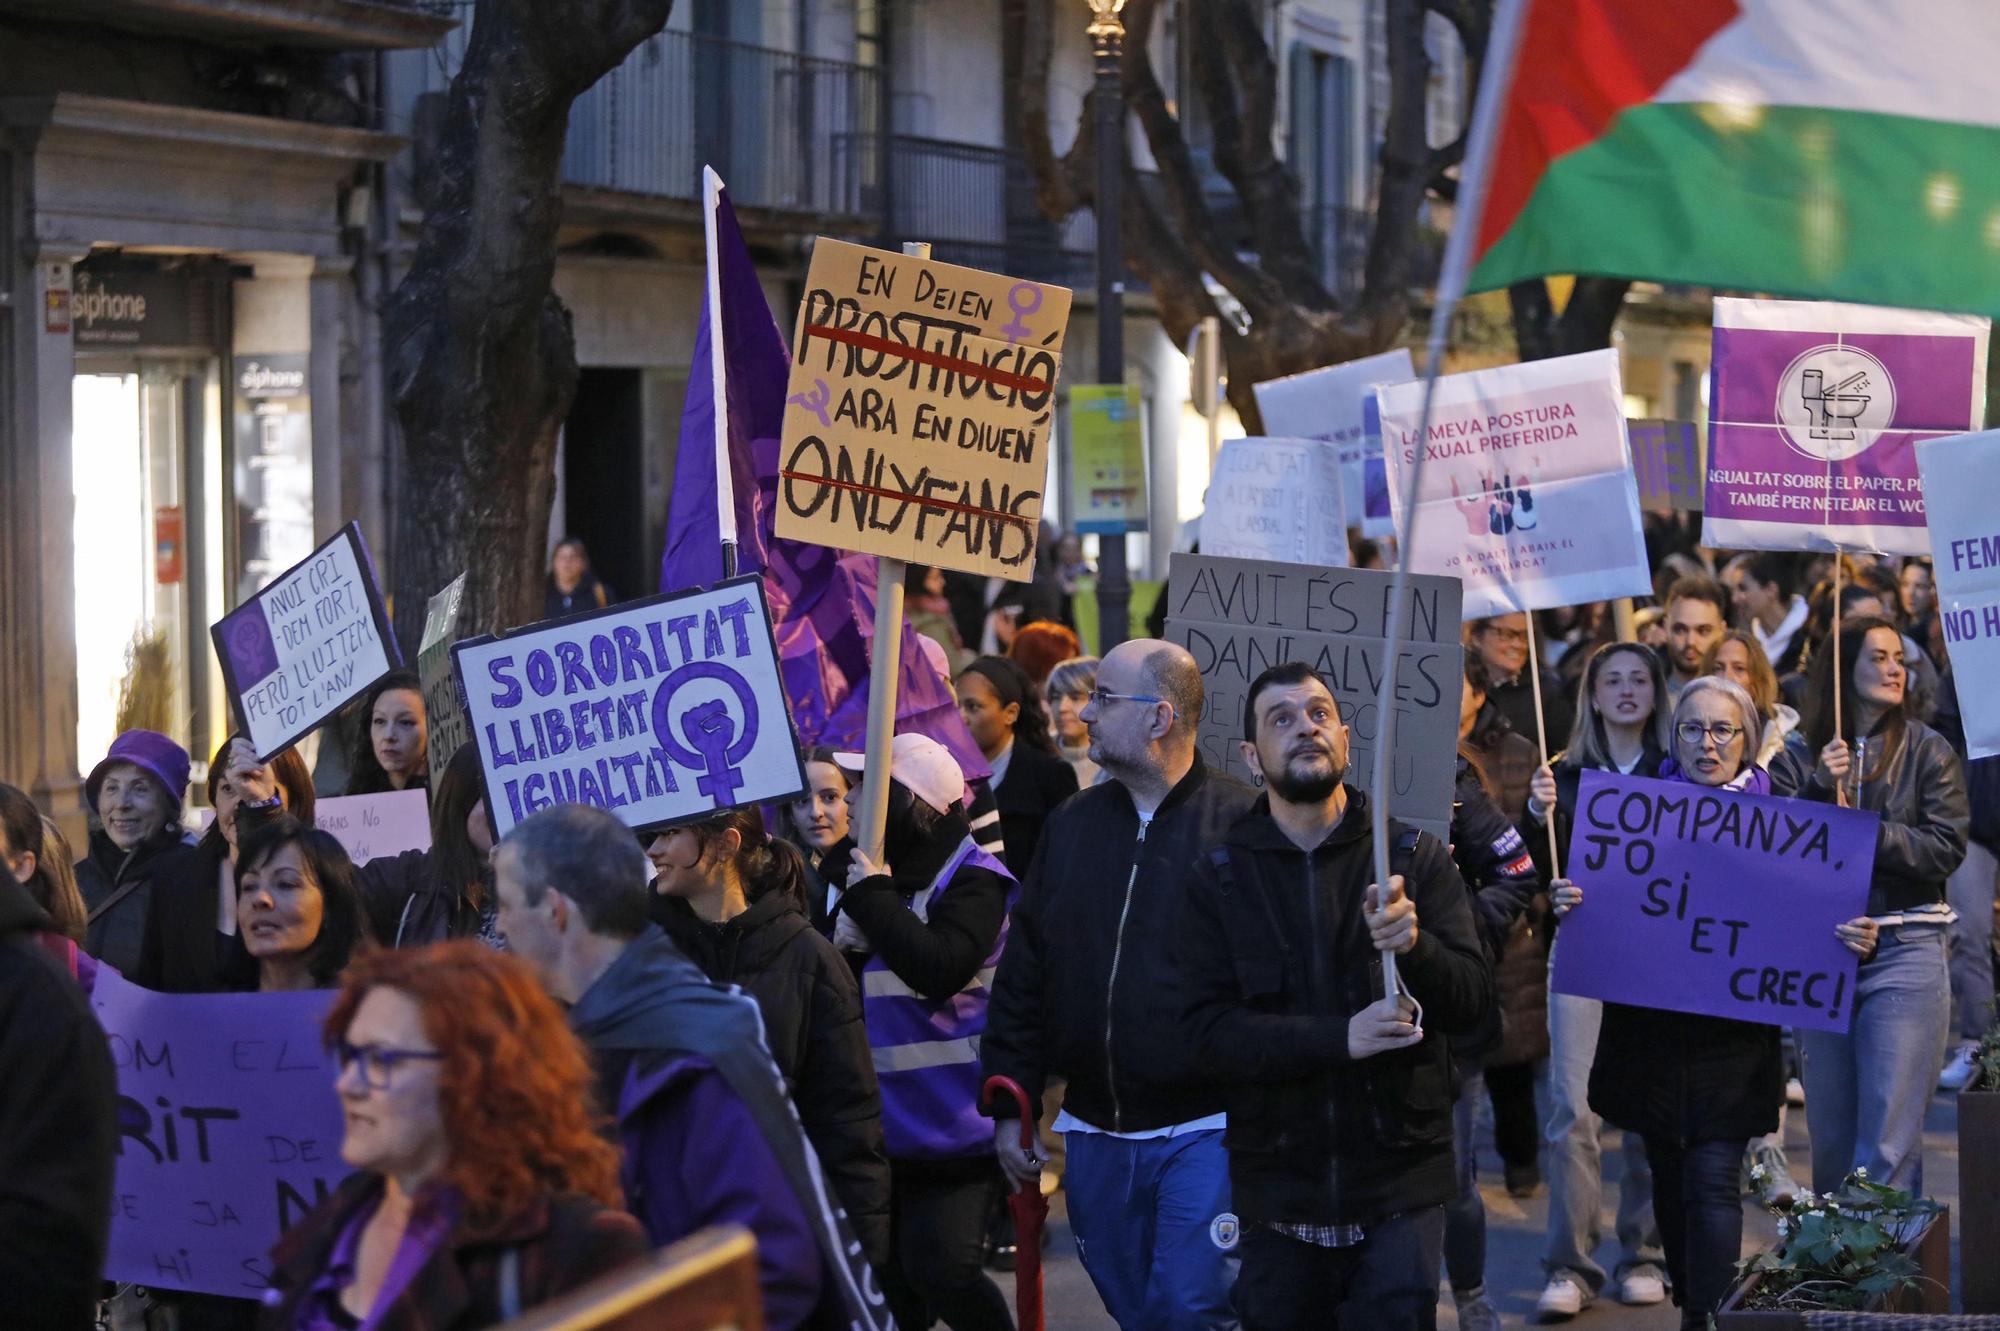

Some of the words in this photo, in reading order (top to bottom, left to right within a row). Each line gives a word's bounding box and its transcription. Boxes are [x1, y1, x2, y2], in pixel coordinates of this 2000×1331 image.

[857, 256, 897, 299] EN
[914, 269, 992, 321] DEIEN
[834, 388, 897, 434] ARA
[912, 403, 952, 442] EN
[958, 417, 1036, 463] DIUEN
[1404, 440, 1475, 465] SXUAL
[1480, 422, 1578, 451] PREFERIDA
[1428, 418, 1483, 442] MEVA
[1488, 402, 1576, 433] POSTURA
[784, 435, 1040, 567] ONLYFANS
[1709, 469, 1782, 487] IGUALTAT
[1783, 473, 1831, 490] SOBRE
[1835, 477, 1851, 490] EL
[1729, 491, 1780, 508] TAMBÉ
[1782, 495, 1810, 509] PER
[1813, 498, 1875, 512] NETEJAR
[1879, 498, 1896, 512] EL
[1898, 499, 1925, 512] WC
[1446, 556, 1460, 567] JO
[1466, 554, 1473, 562] A
[1478, 548, 1507, 560] DALT
[1520, 540, 1557, 554] ABAIX
[1562, 538, 1575, 548] EL
[1472, 556, 1548, 576] PATRIARCAT
[271, 579, 304, 624] AVUI
[309, 551, 343, 592] CRI
[1180, 567, 1286, 626] AVUI
[1305, 571, 1359, 634] ÉS
[1944, 608, 1977, 642] NO
[247, 671, 290, 722] PERÒ
[294, 615, 374, 690] LLUITEM
[488, 597, 755, 709] SORORITAT
[1314, 644, 1441, 708] ALVES
[276, 697, 306, 731] TOT
[312, 661, 355, 708] L'ANY
[485, 689, 649, 770] LLIBETAT
[503, 747, 680, 827] IGUALTAT
[1584, 834, 1656, 875] JO
[1586, 787, 1844, 871] COMPANYA,
[1690, 917, 1749, 957] ET
[1729, 967, 1845, 1019] CREC!
[233, 1040, 320, 1073] EL
[265, 1135, 322, 1163] DE
[192, 1200, 241, 1226] JA
